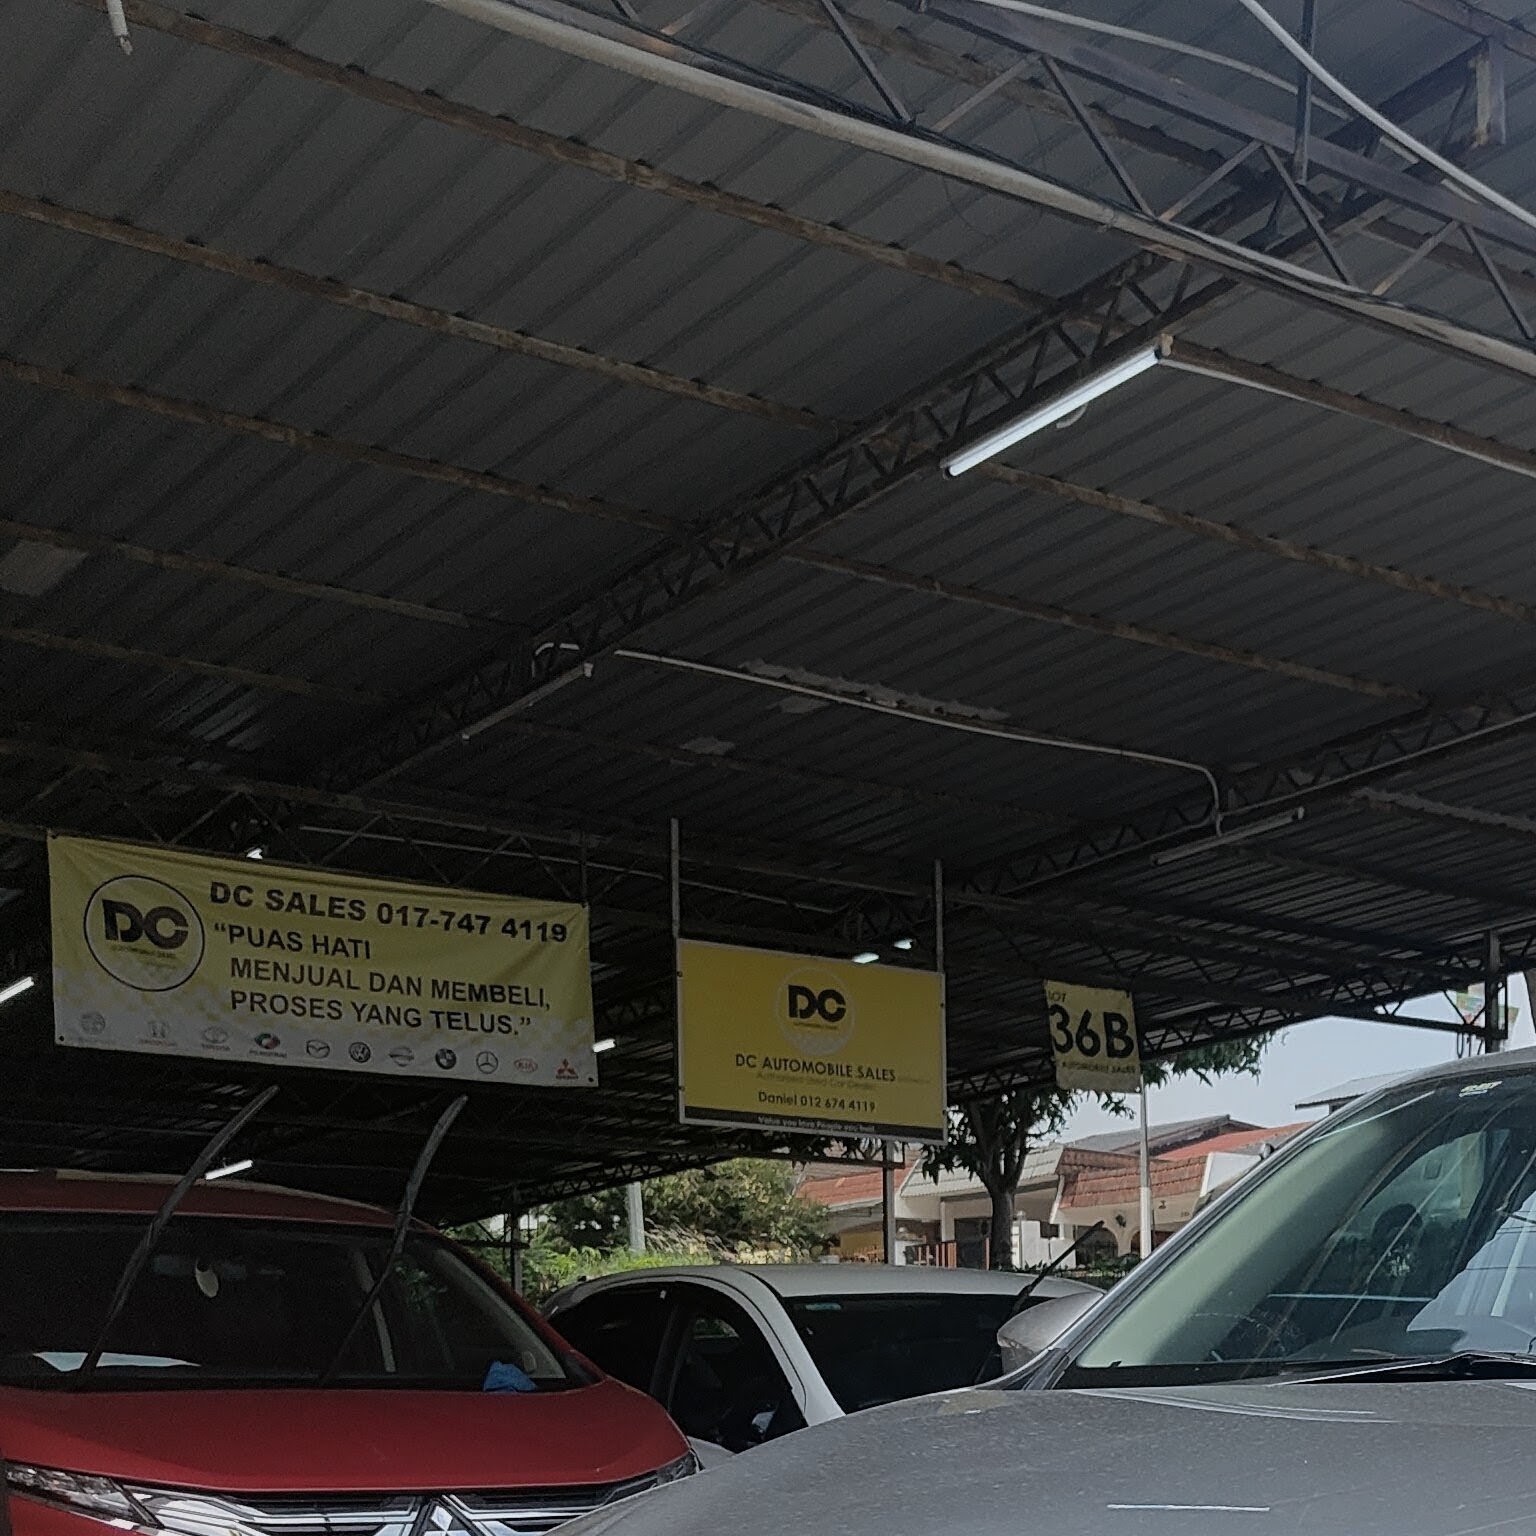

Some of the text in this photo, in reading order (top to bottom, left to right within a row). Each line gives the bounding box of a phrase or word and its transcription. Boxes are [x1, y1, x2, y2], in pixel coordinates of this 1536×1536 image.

[102, 899, 189, 949] DC
[210, 881, 567, 943] DC SALES 017-747 4119
[312, 934, 370, 960] HATI
[231, 957, 550, 1012] MENJUAL DAN MEMBELI,
[788, 984, 846, 1023] DC
[230, 990, 343, 1020] PROSES
[351, 1001, 422, 1029] YANG
[1049, 1004, 1135, 1058] 36B
[735, 1053, 896, 1083] DC AUTOMOBILE SALES
[758, 1091, 876, 1113] Daniel 012 674 4119
